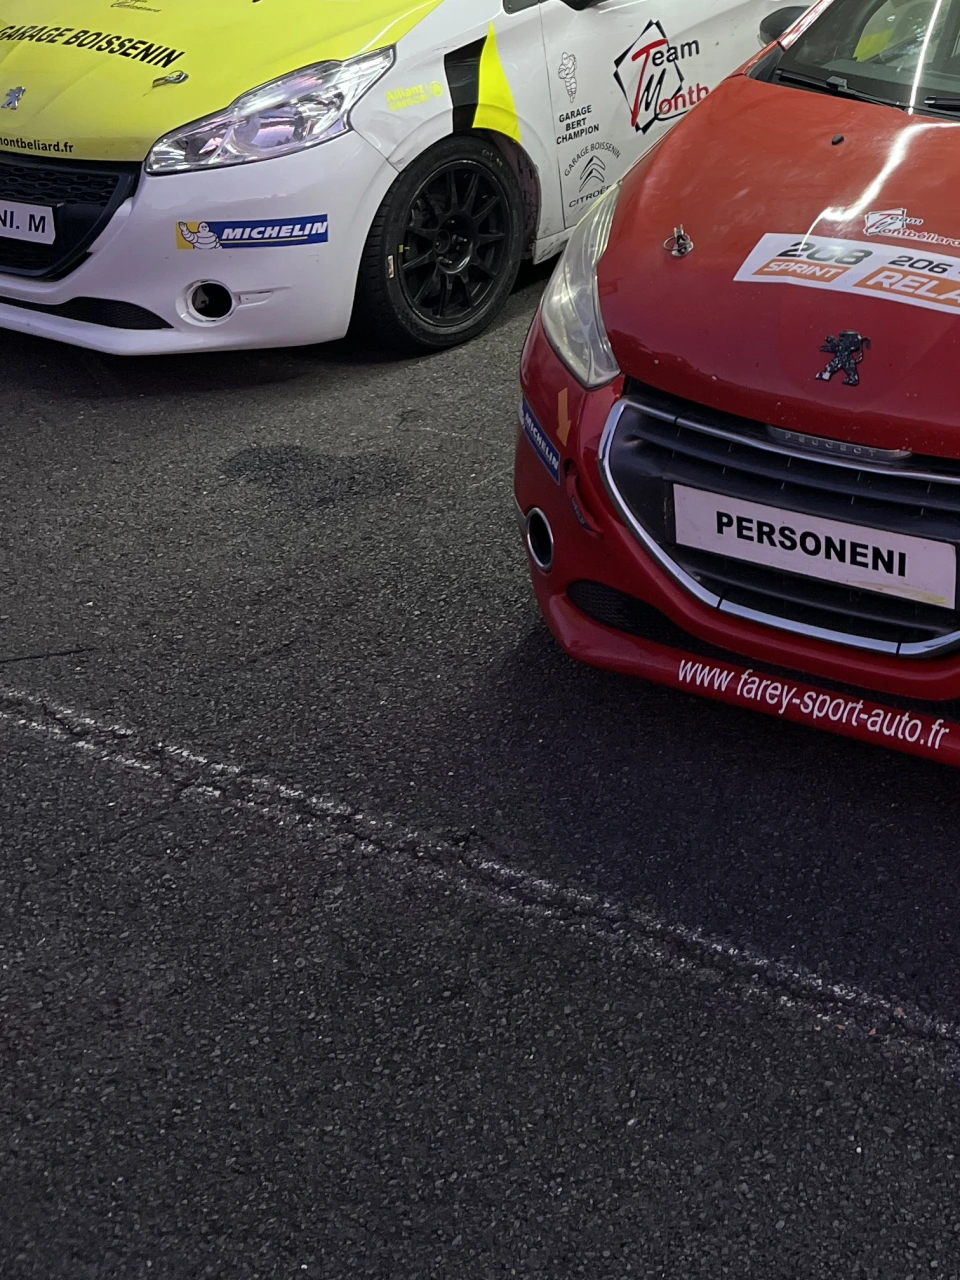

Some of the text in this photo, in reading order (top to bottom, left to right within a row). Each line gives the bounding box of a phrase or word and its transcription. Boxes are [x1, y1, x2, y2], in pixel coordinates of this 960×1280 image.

[0, 25, 185, 68] GARAGE BOISSENIN
[631, 37, 700, 127] Team
[559, 105, 592, 123] GARAGE
[565, 117, 587, 132] BERT
[556, 123, 600, 145] CHAMPION
[564, 141, 621, 177] GARAGE BOISSENIN
[28, 214, 46, 234] M
[221, 221, 328, 240] MICHELIN
[777, 241, 873, 266] 208
[887, 255, 954, 275] 206
[764, 261, 843, 279] SPRINT
[525, 412, 559, 471] MICHELIN
[785, 432, 877, 457] PEUGEOT
[716, 511, 906, 577] PERSONENI
[678, 659, 950, 749] www farey-sport-auto.fr
